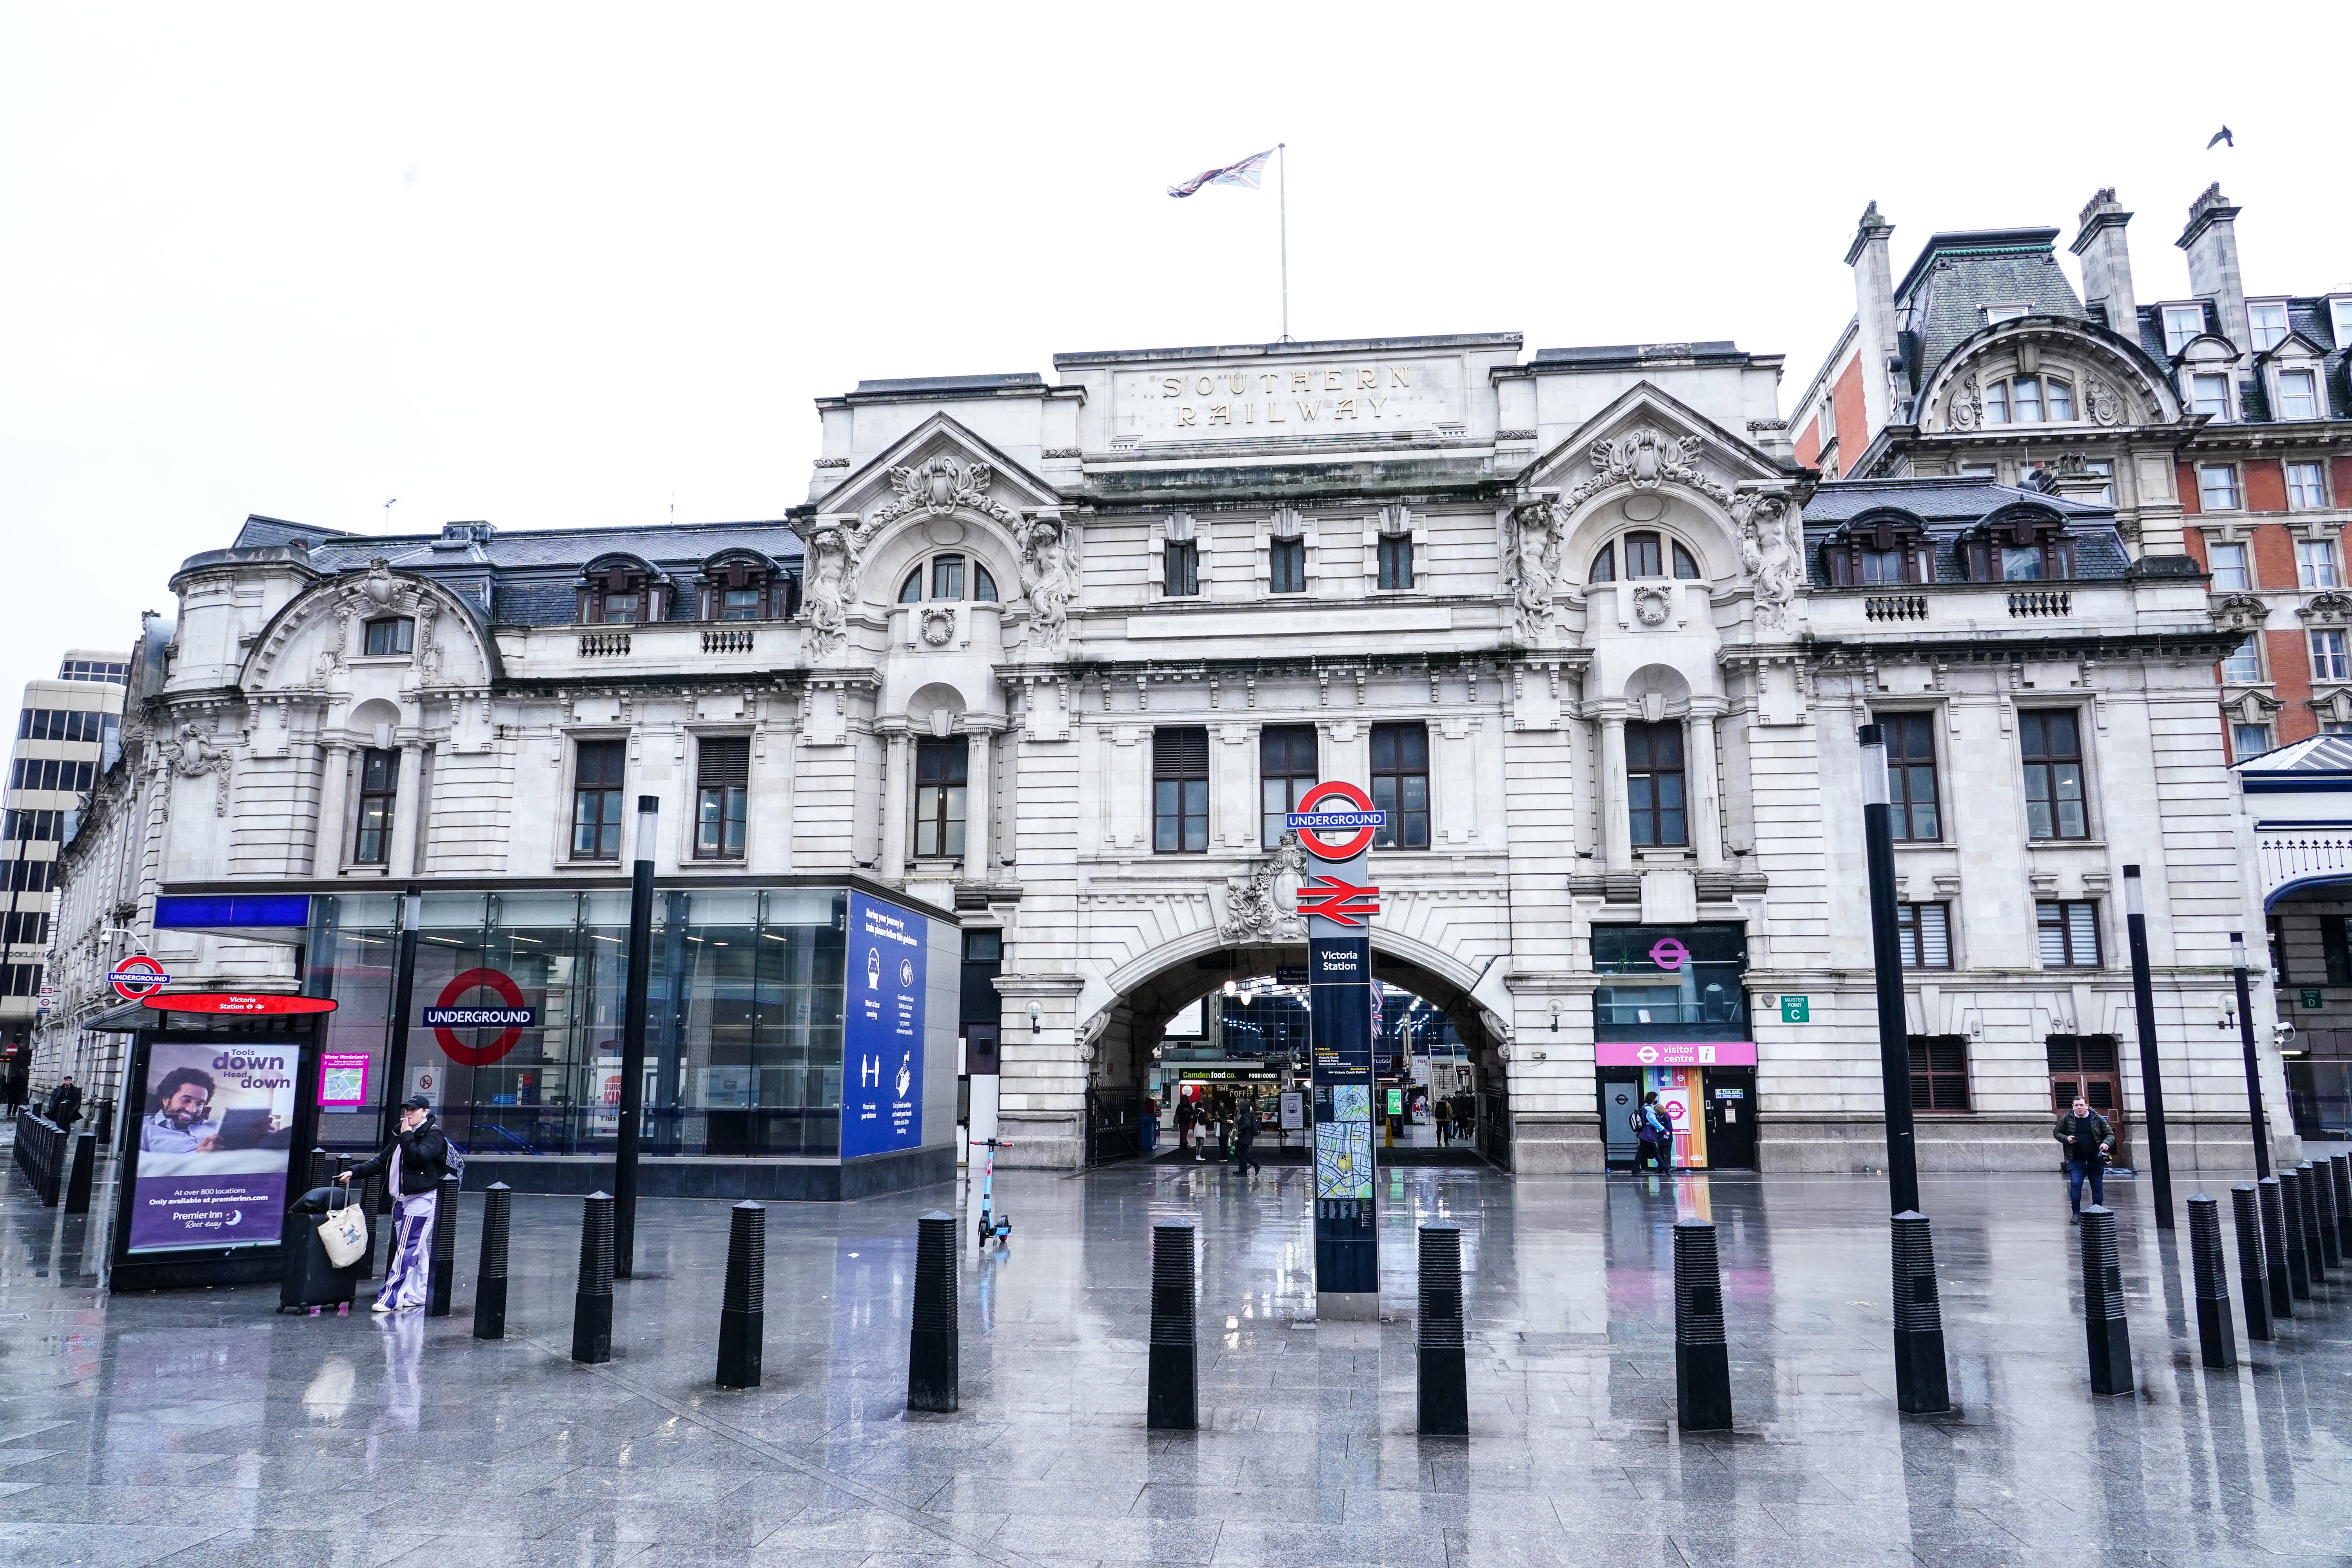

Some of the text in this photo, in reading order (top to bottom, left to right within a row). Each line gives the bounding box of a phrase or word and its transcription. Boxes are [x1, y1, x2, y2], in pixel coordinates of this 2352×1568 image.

[1162, 367, 1409, 397] SOUTHERN
[1289, 814, 1382, 826] UNDERGROUND
[866, 908, 904, 931] During your journey by
[866, 922, 875, 933] train
[875, 925, 886, 936] please
[886, 928, 897, 940] follow
[903, 935, 917, 946] guidance
[1321, 951, 1357, 960] Victoria
[1323, 962, 1356, 971] Station
[110, 974, 168, 982] UNDERGROUND
[428, 1011, 530, 1023] UNDERGROUND
[866, 1011, 878, 1020] covering
[1791, 1009, 1800, 1020] C
[212, 1052, 284, 1070] down
[241, 1076, 290, 1088] down
[211, 1195, 268, 1203] premierinn.com
[173, 1210, 223, 1220] Premier Inn
[185, 1220, 222, 1229] Rest easy
